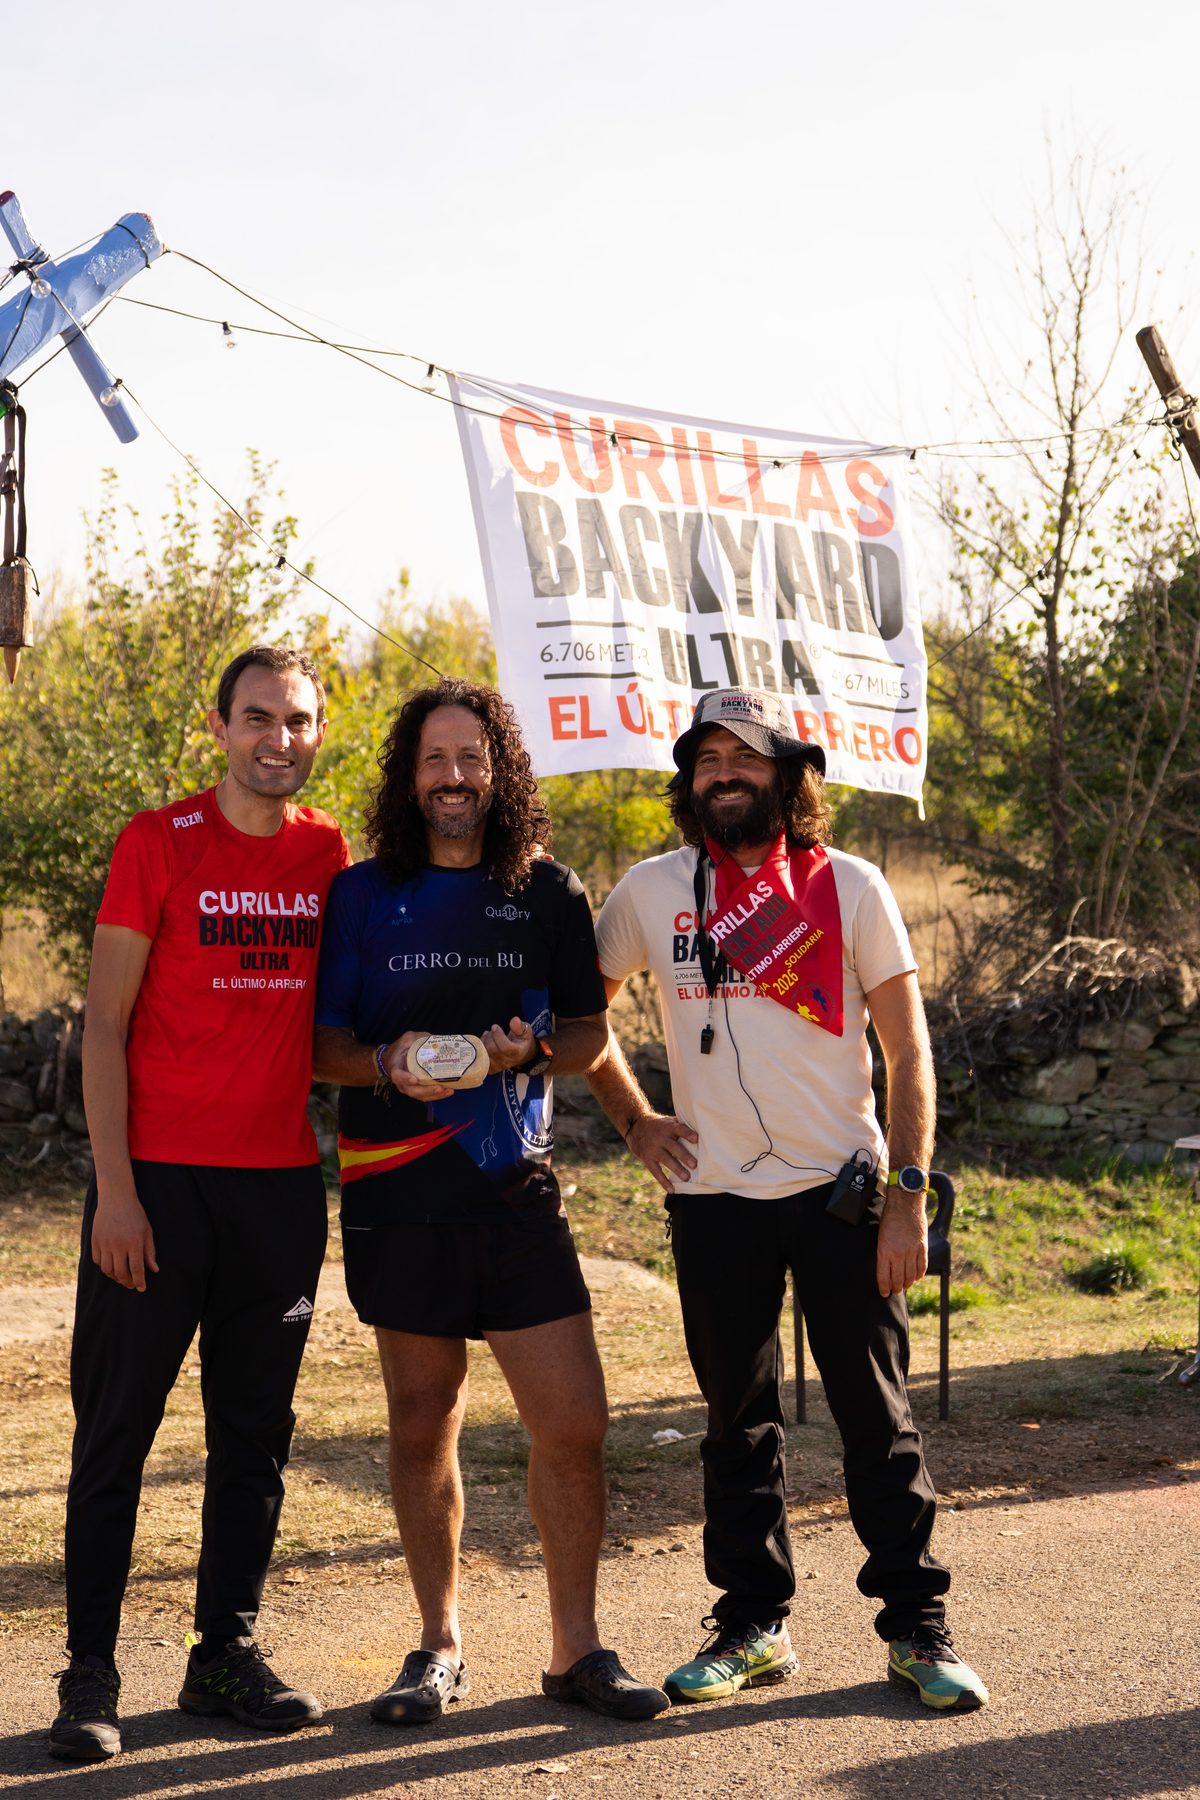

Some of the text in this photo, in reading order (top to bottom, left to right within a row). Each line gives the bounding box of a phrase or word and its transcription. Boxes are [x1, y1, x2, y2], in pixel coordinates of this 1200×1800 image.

[500, 406, 894, 537] CURILLAS
[515, 491, 903, 641] BACKYARD
[540, 642, 595, 663] 6.706
[657, 626, 820, 695] ULTRA
[867, 675, 909, 699] MILES
[548, 695, 608, 740] EL
[721, 700, 763, 712] BACKYARD
[199, 891, 319, 917] CURILLAS
[485, 904, 531, 921] Qualery
[200, 916, 319, 949] BACKYARD
[771, 921, 809, 959] ARRIERO
[240, 952, 290, 970] ULTRA
[784, 928, 825, 969] SOLIDARIA
[388, 952, 462, 972] CERRO
[468, 957, 492, 968] DEL
[212, 978, 228, 989] EL
[230, 975, 266, 989] ÚLTIMO
[677, 987, 692, 1000] EL
[772, 968, 799, 996] 2026
